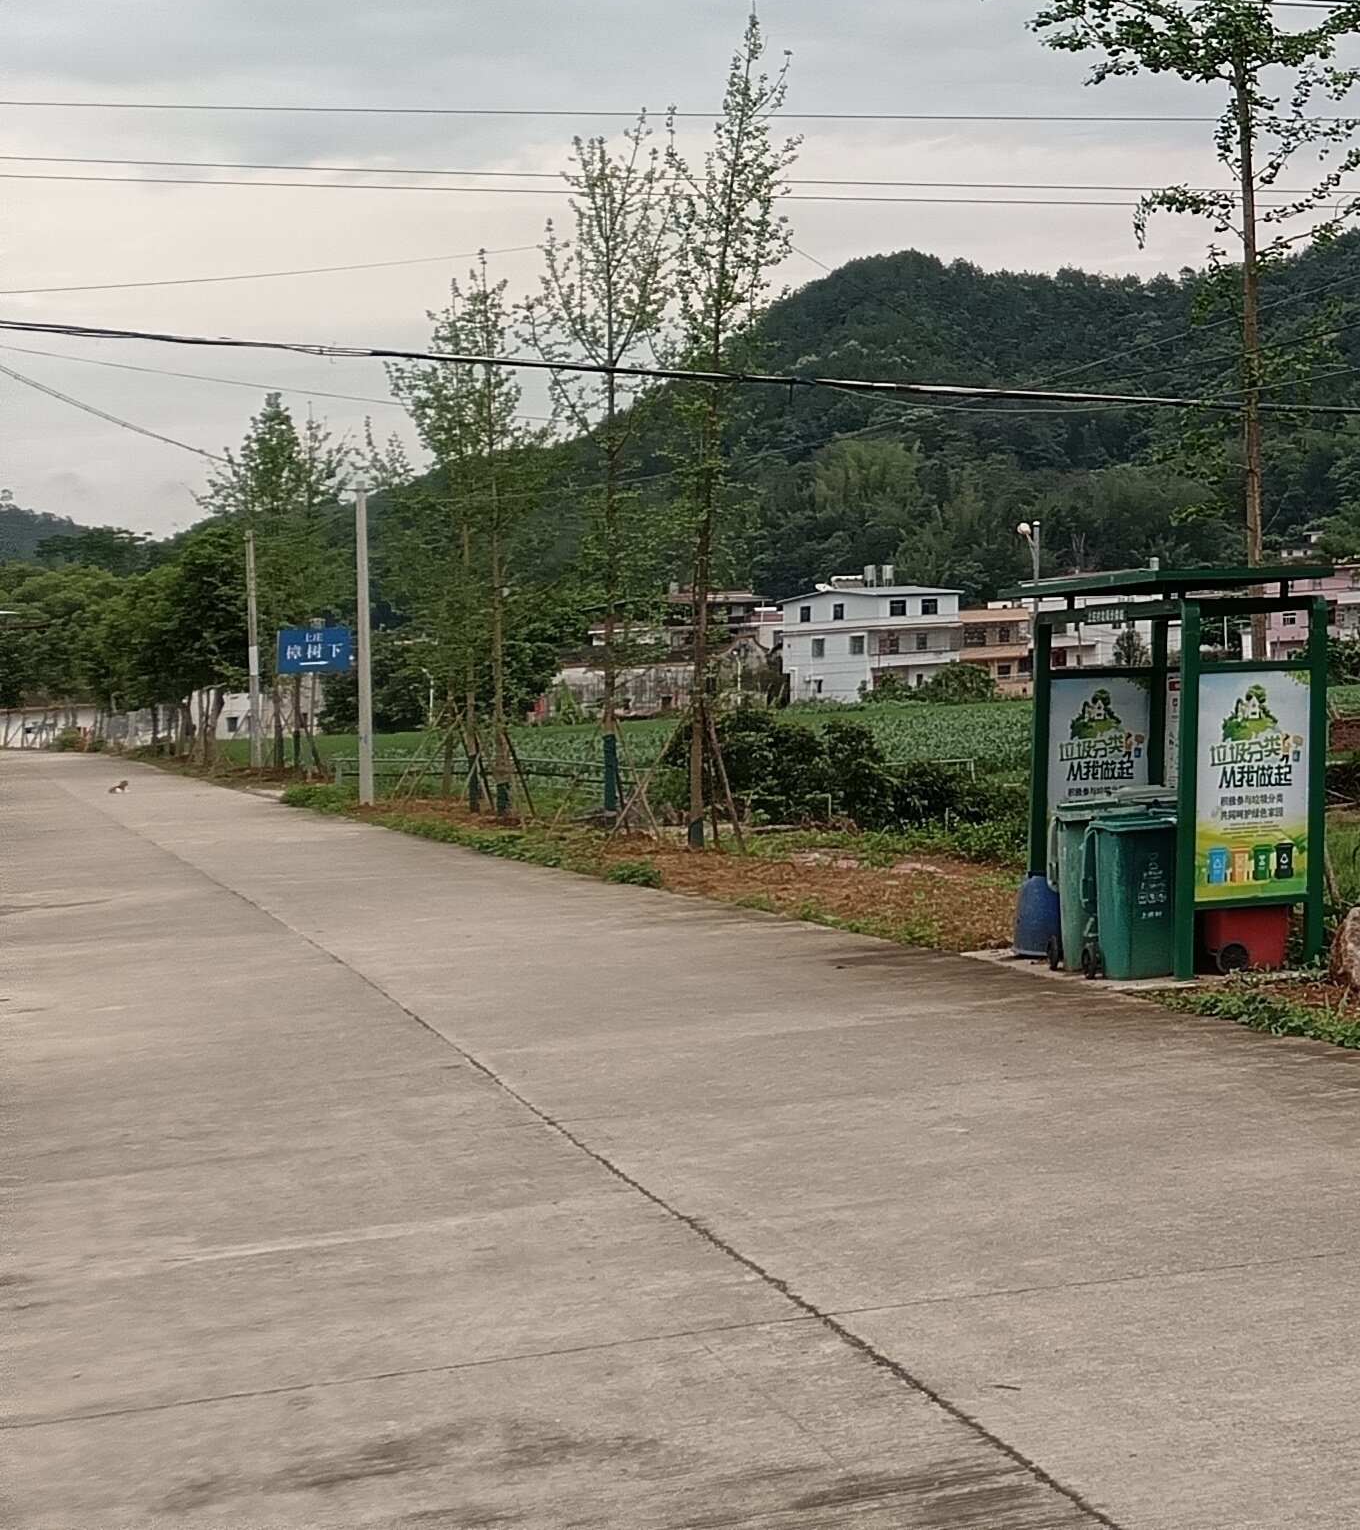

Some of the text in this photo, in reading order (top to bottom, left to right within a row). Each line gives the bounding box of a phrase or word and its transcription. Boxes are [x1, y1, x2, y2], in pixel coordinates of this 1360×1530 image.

[286, 643, 344, 660] 樟树下
[1059, 735, 1124, 761] 垃圾分类
[1210, 735, 1282, 767] 垃圾分类
[1066, 760, 1134, 781] 从我做起
[1218, 764, 1292, 789] 从我做起
[1220, 793, 1284, 807] 积极参与垃圾分类
[1220, 807, 1284, 821] 共同呵护绿色家园
